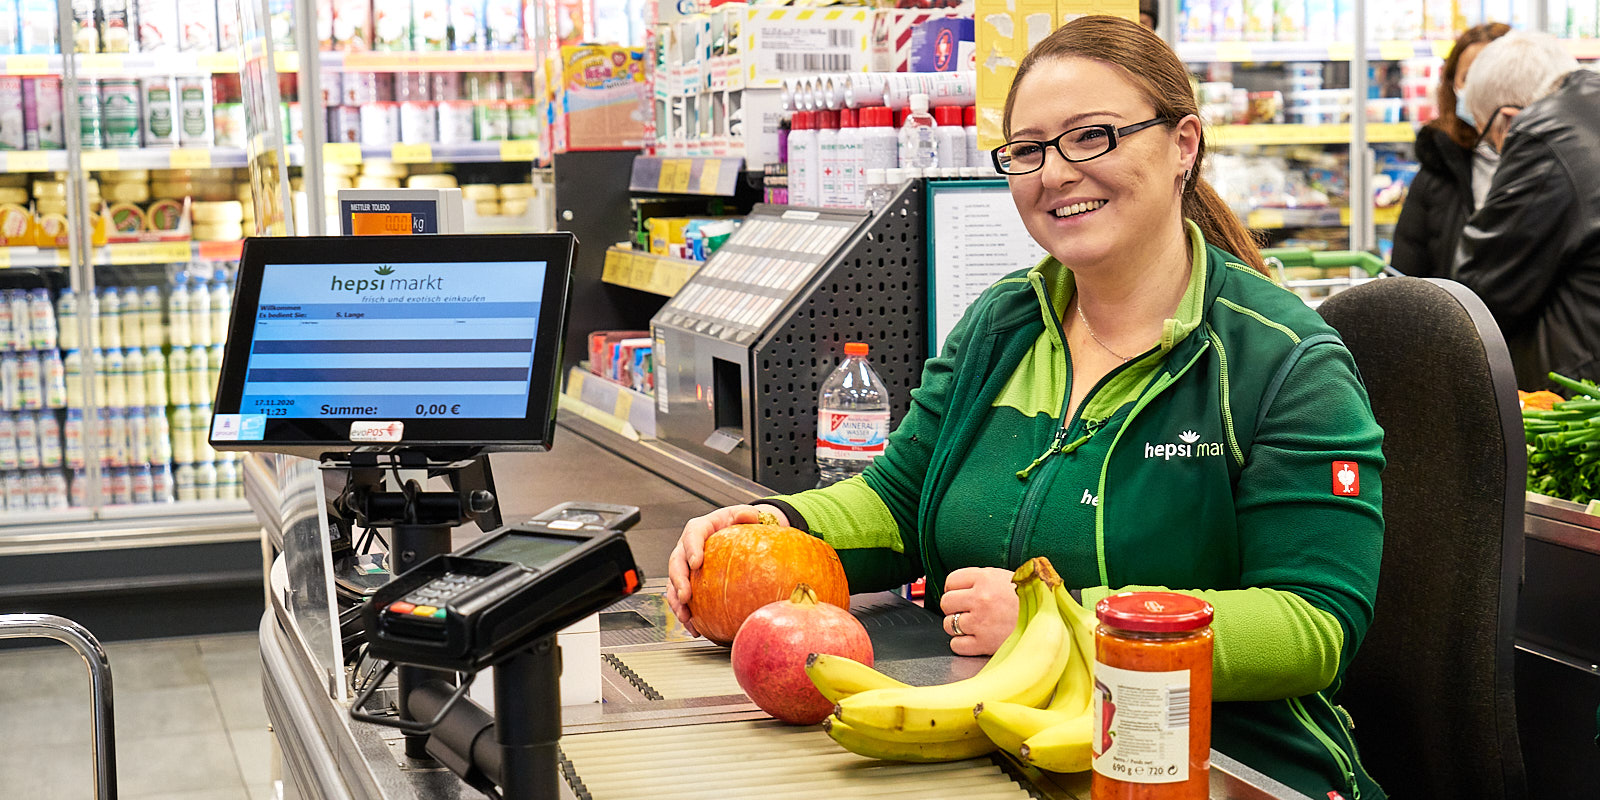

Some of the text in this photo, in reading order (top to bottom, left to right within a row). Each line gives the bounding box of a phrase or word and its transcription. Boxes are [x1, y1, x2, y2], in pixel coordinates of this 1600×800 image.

[350, 203, 390, 211] METTLER TOLEDO
[413, 216, 424, 232] kg
[331, 274, 444, 294] hepsi markt
[361, 294, 486, 303] frisch und exotisch einkaufen
[320, 404, 461, 416] Summe: 0,00 €
[351, 428, 384, 437] evoPOS
[1144, 442, 1191, 460] hepsi
[1112, 763, 1164, 776] 690 g 720
